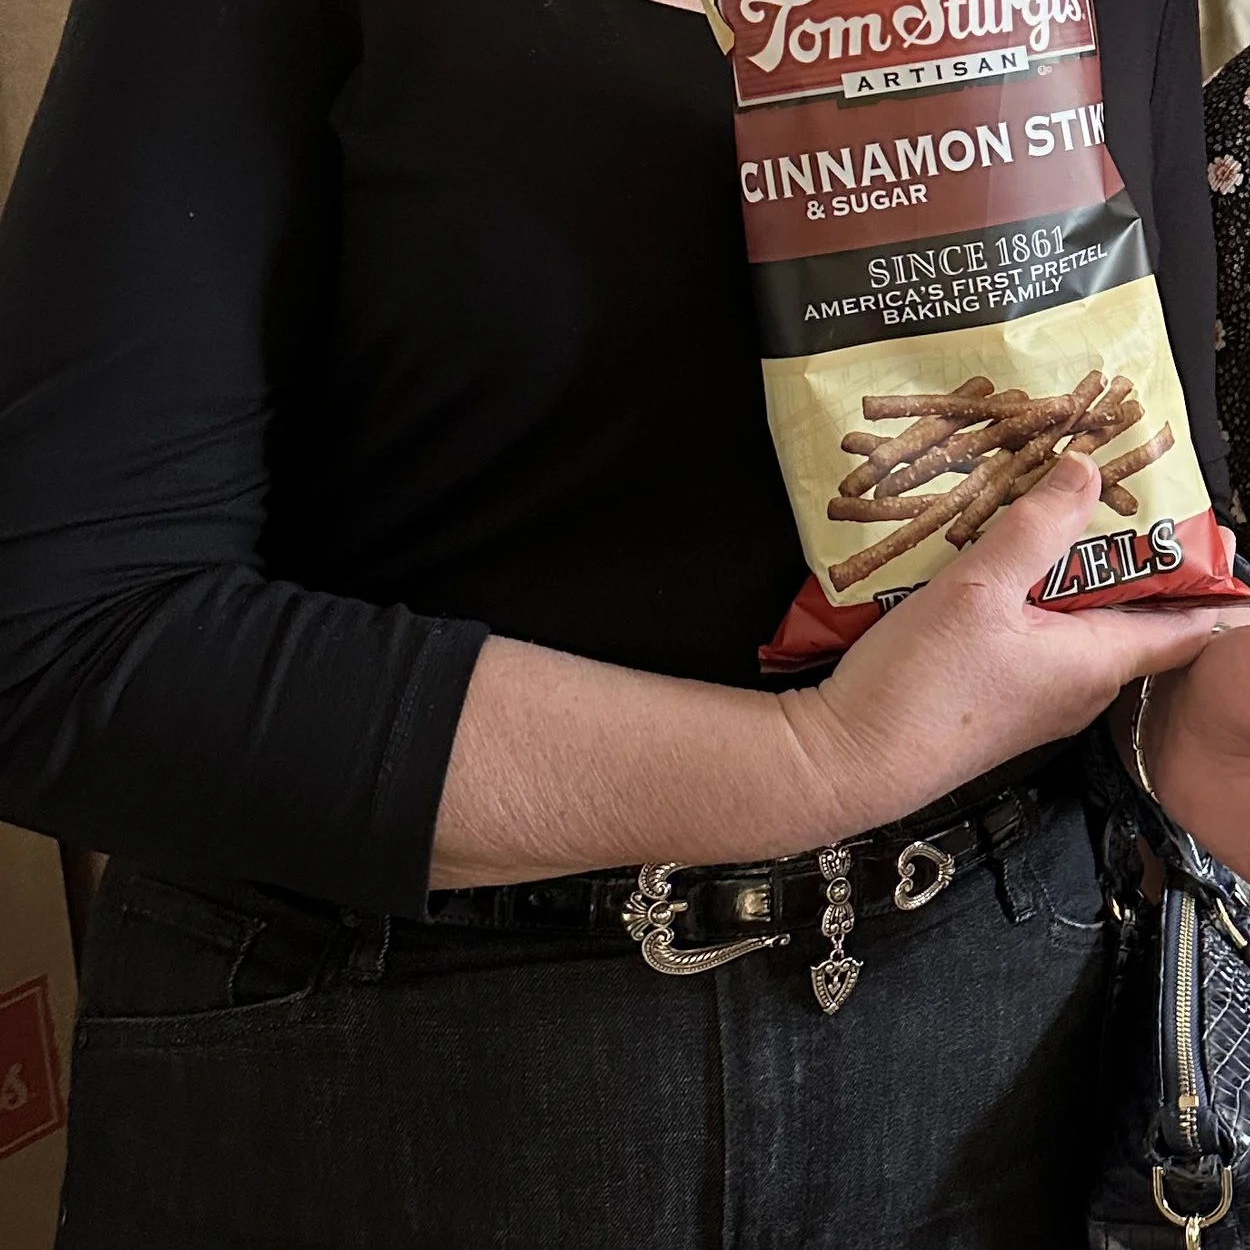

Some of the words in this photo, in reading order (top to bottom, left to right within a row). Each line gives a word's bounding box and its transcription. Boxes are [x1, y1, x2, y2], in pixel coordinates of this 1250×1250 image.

[857, 52, 1018, 92] ARTISAN
[740, 121, 1014, 204] CINNAMON
[1024, 101, 1105, 157] STIK
[806, 200, 826, 221] &
[832, 183, 928, 217] SUGAR
[804, 283, 945, 322] AMERICA'S
[952, 267, 1023, 296] FIRST
[1031, 243, 1108, 282] PRETZEL
[868, 241, 988, 289] SINCE
[995, 225, 1066, 267] 1861
[882, 294, 980, 326] BAKING
[988, 276, 1064, 310] FAMILY
